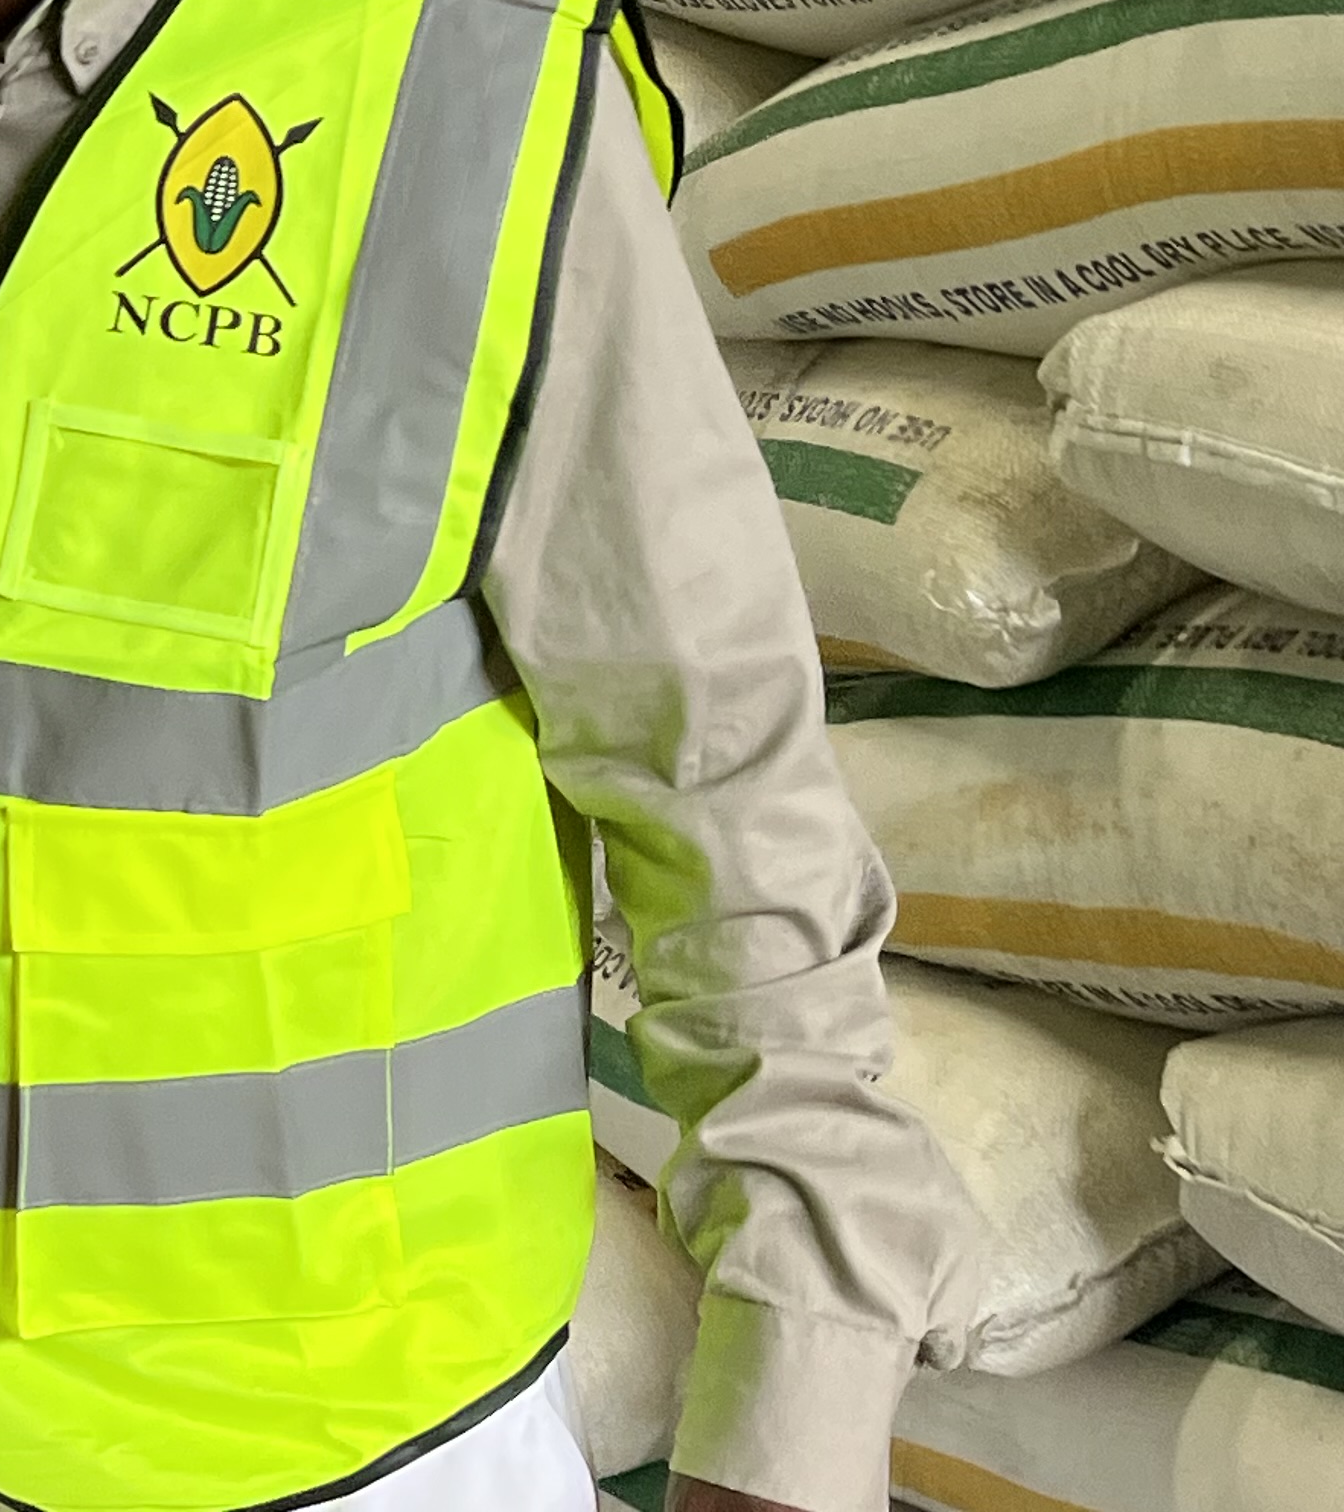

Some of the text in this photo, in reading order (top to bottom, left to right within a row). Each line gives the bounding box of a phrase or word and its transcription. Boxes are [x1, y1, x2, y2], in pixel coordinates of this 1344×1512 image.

[106, 290, 283, 358] NCPB
[775, 310, 832, 334] USE
[815, 302, 863, 327] NO
[940, 280, 1038, 317] STORE
[1021, 274, 1068, 304] IN
[1054, 269, 1090, 299] A
[1075, 252, 1158, 289] COOL
[1140, 235, 1207, 271] DRY
